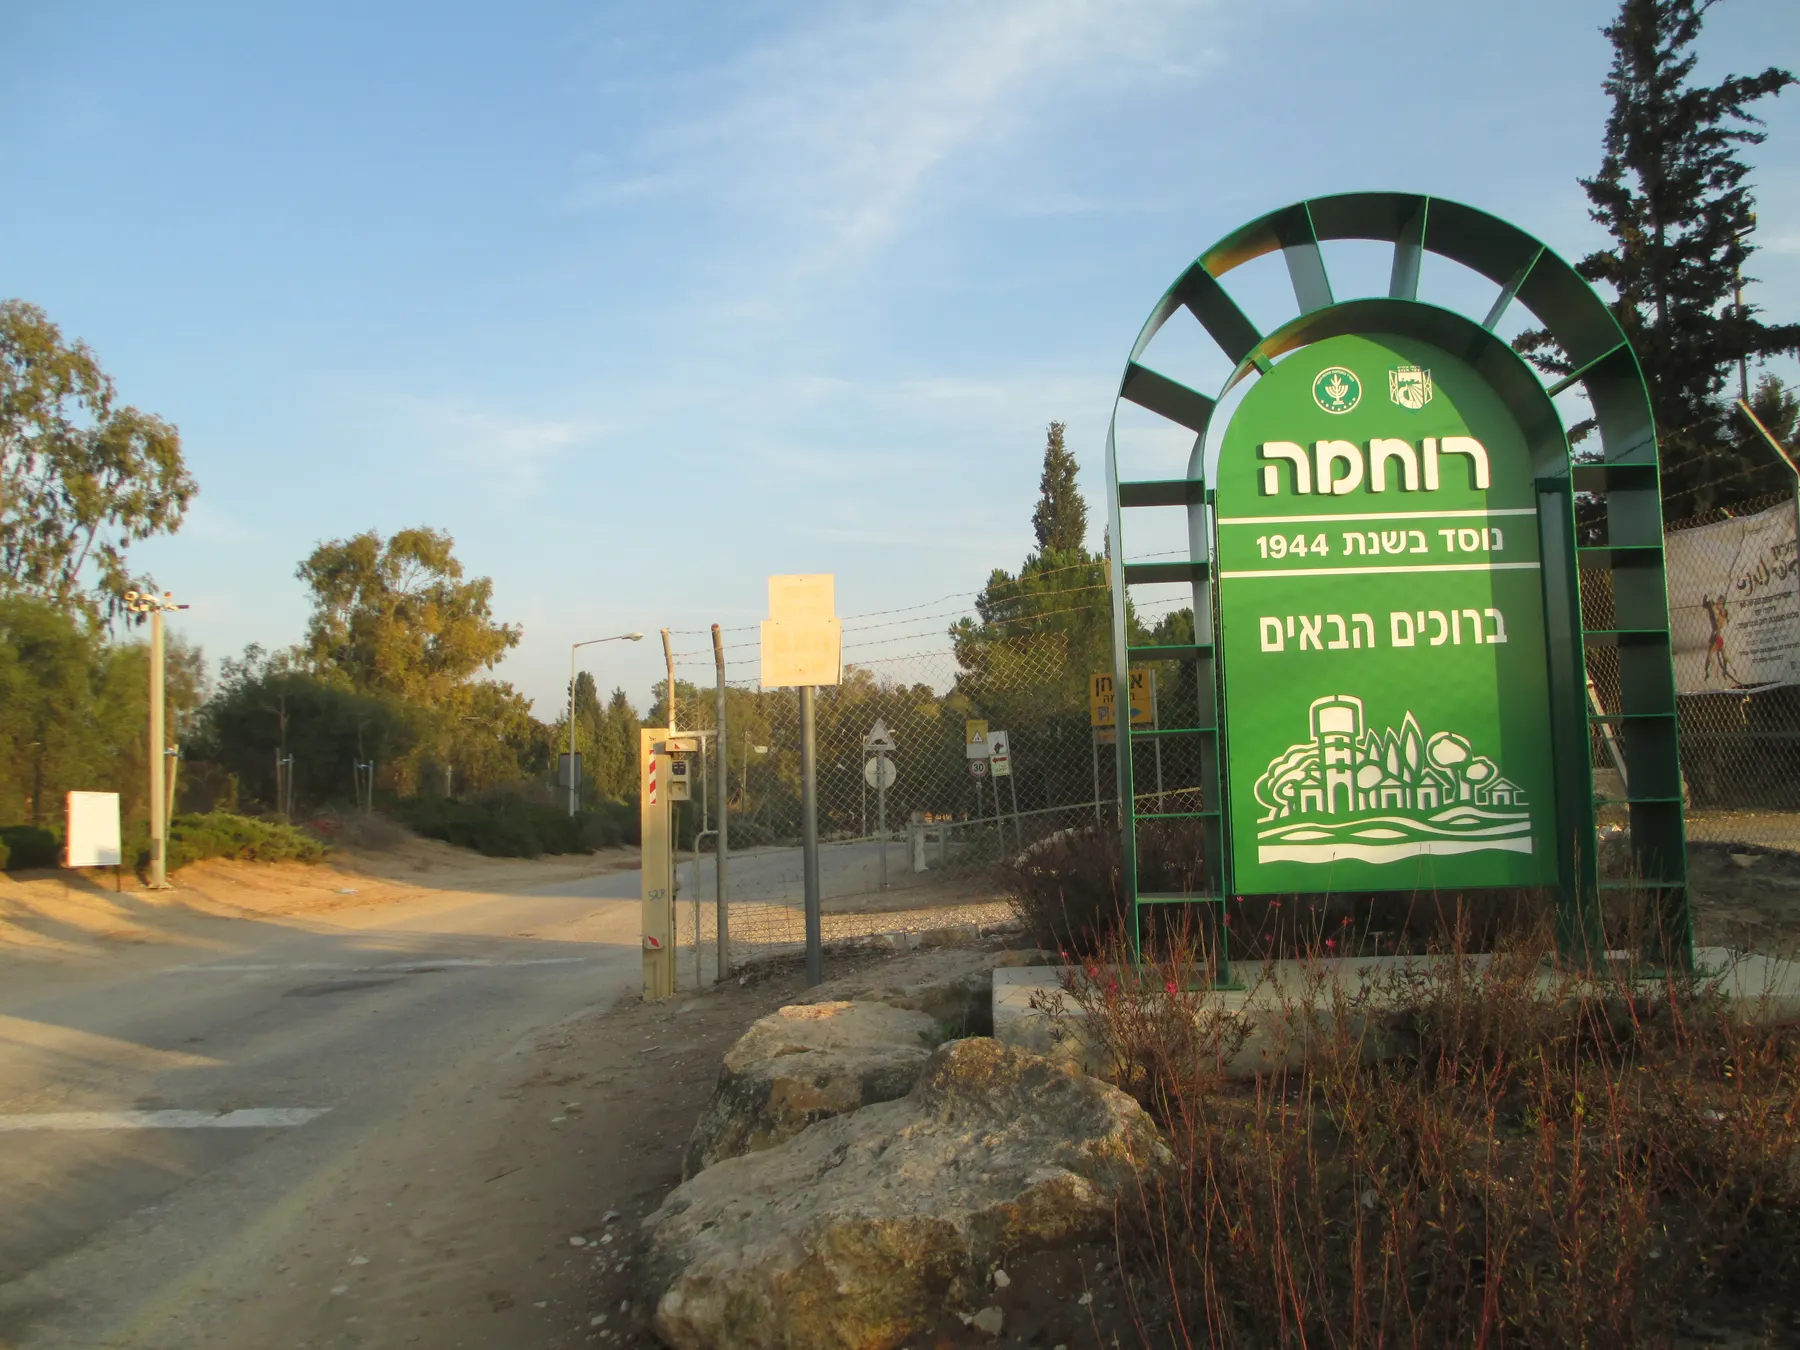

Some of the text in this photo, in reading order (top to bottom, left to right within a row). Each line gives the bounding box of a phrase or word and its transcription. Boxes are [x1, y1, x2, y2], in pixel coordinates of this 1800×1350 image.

[1262, 437, 1490, 496] רוחמה
[1256, 527, 1504, 560] נוסד בשנת 1944
[1259, 607, 1508, 653] ברוכים הבאים
[973, 762, 985, 773] 30
